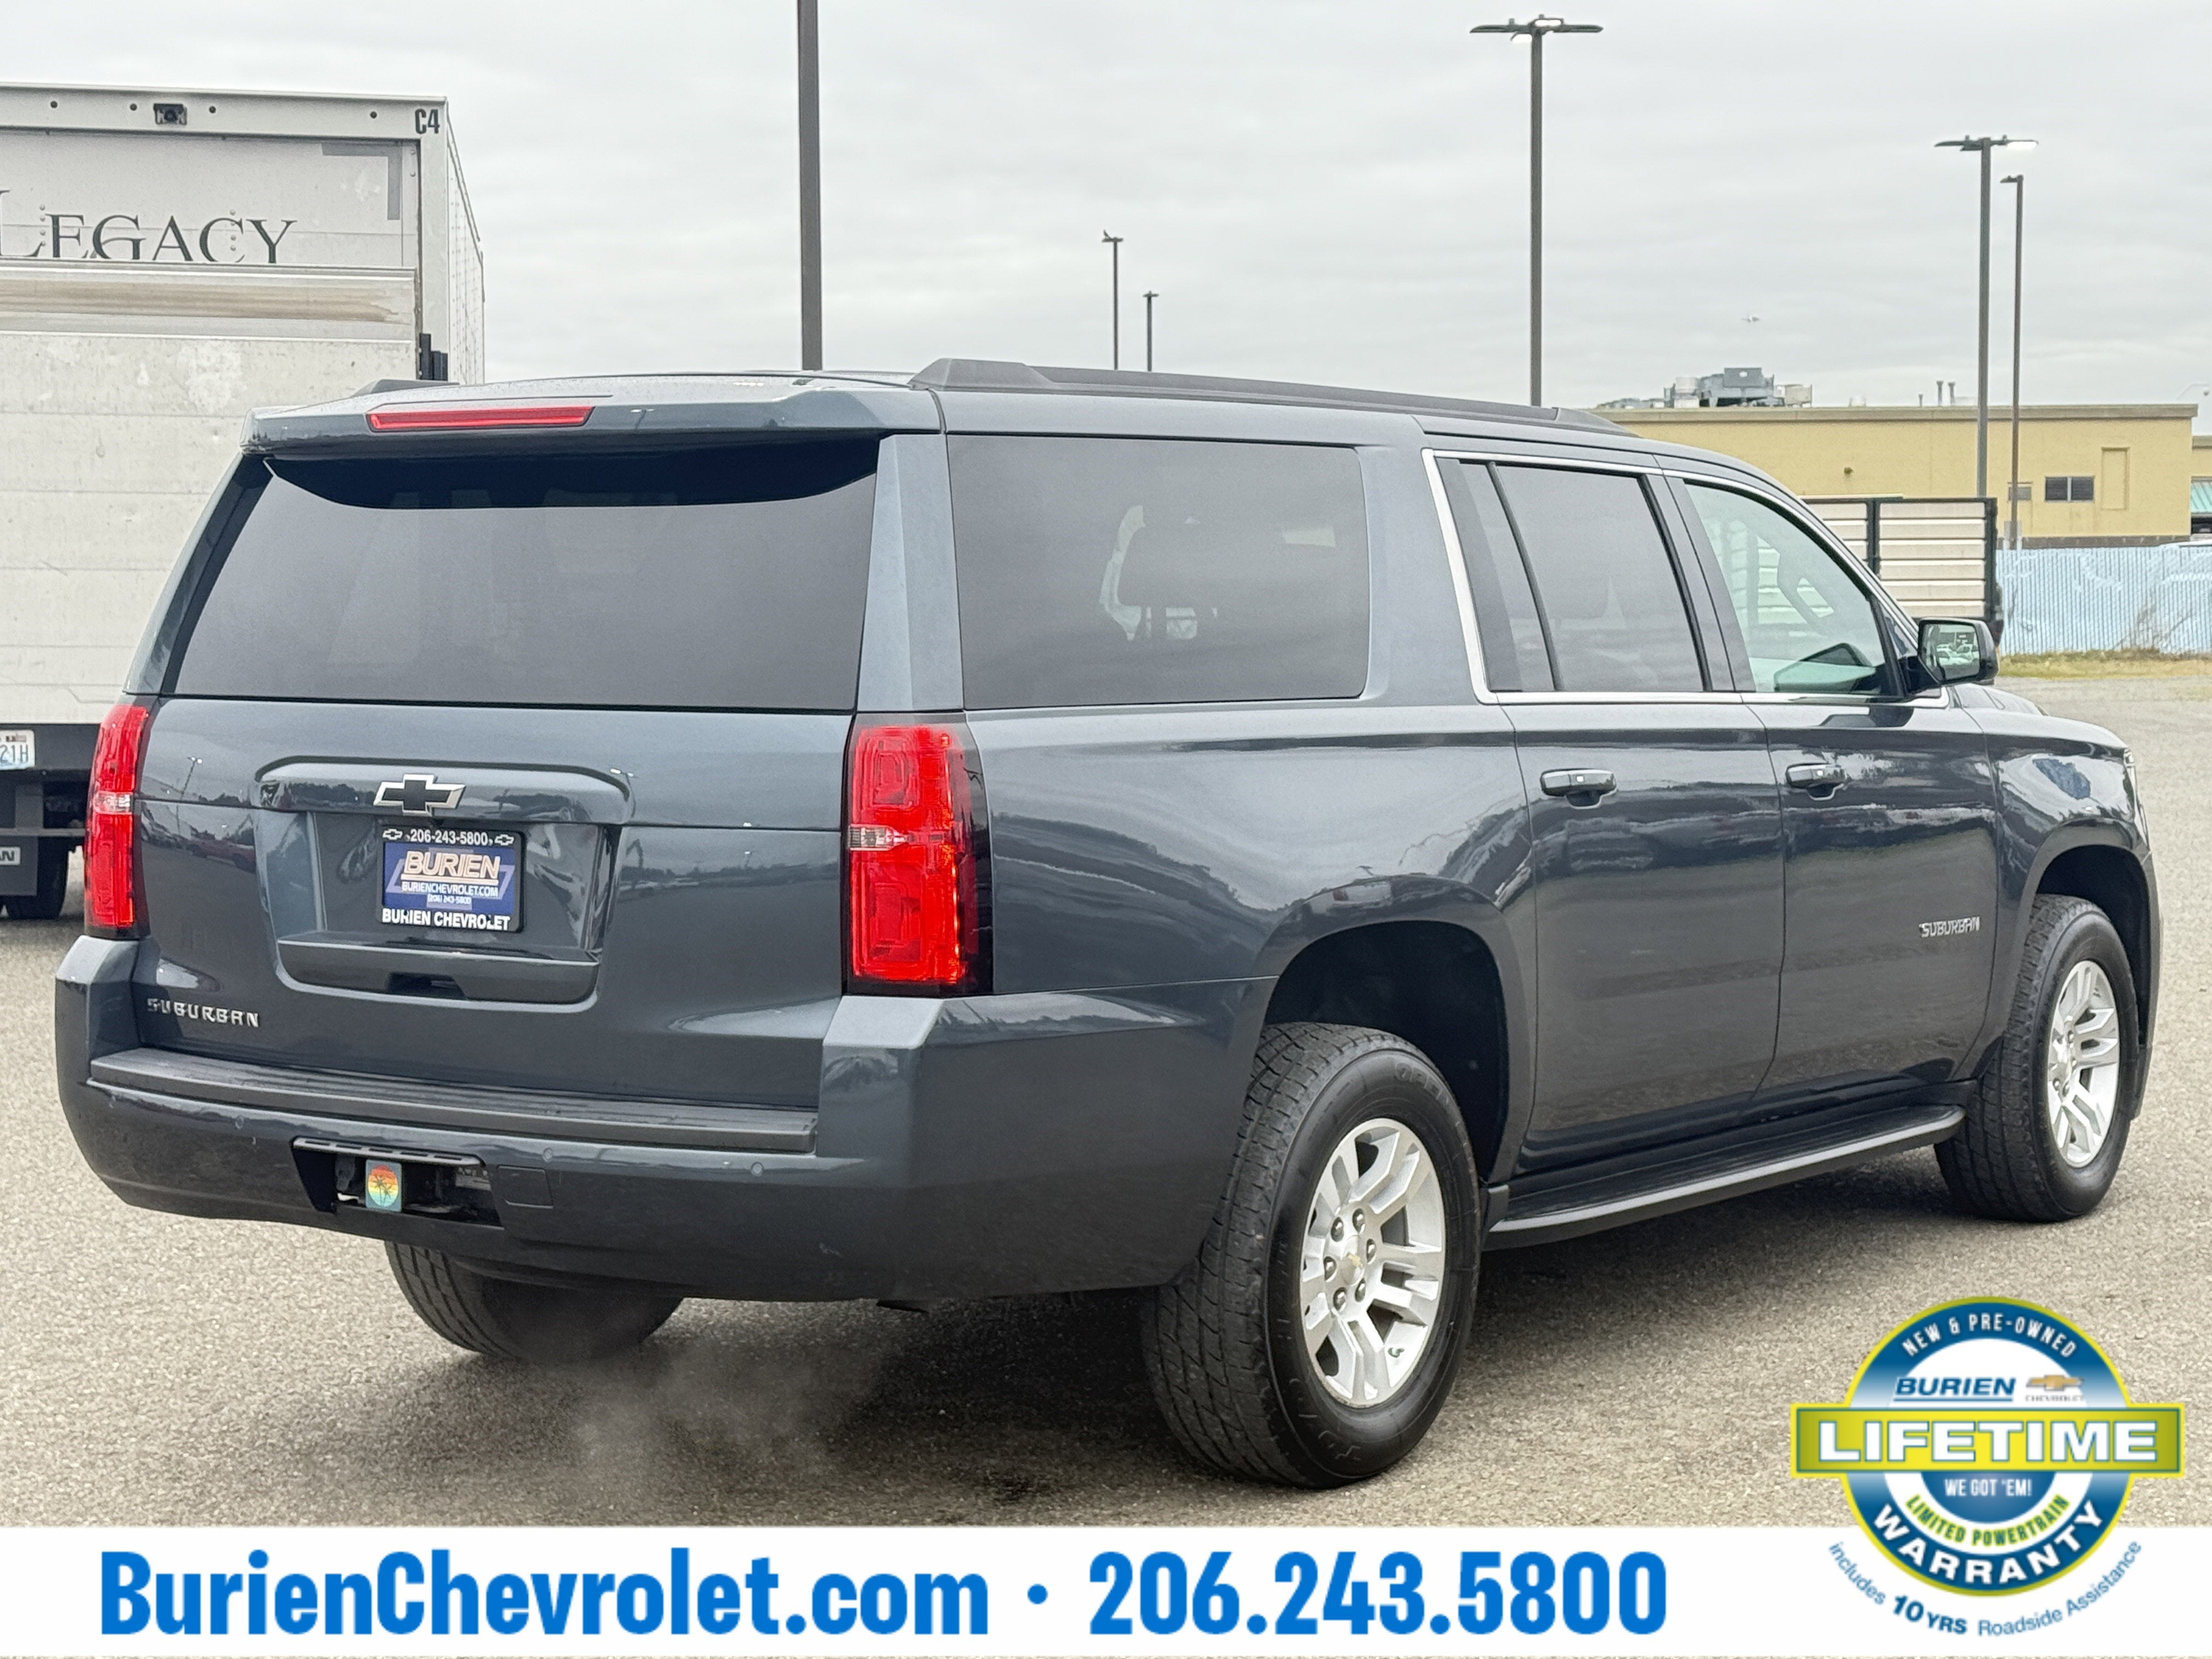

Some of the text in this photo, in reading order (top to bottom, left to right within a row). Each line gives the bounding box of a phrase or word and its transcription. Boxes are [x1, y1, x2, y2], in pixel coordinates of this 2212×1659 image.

[415, 109, 440, 134] C4
[410, 829, 489, 845] 206-243-5800
[403, 851, 500, 879] BURIEN
[402, 881, 499, 897] BURIENCHEVROLET.COM
[382, 908, 511, 930] BURIEN CHEVROLET
[1920, 916, 1980, 938] SUBURBAN
[147, 998, 259, 1028] SUBURBAN
